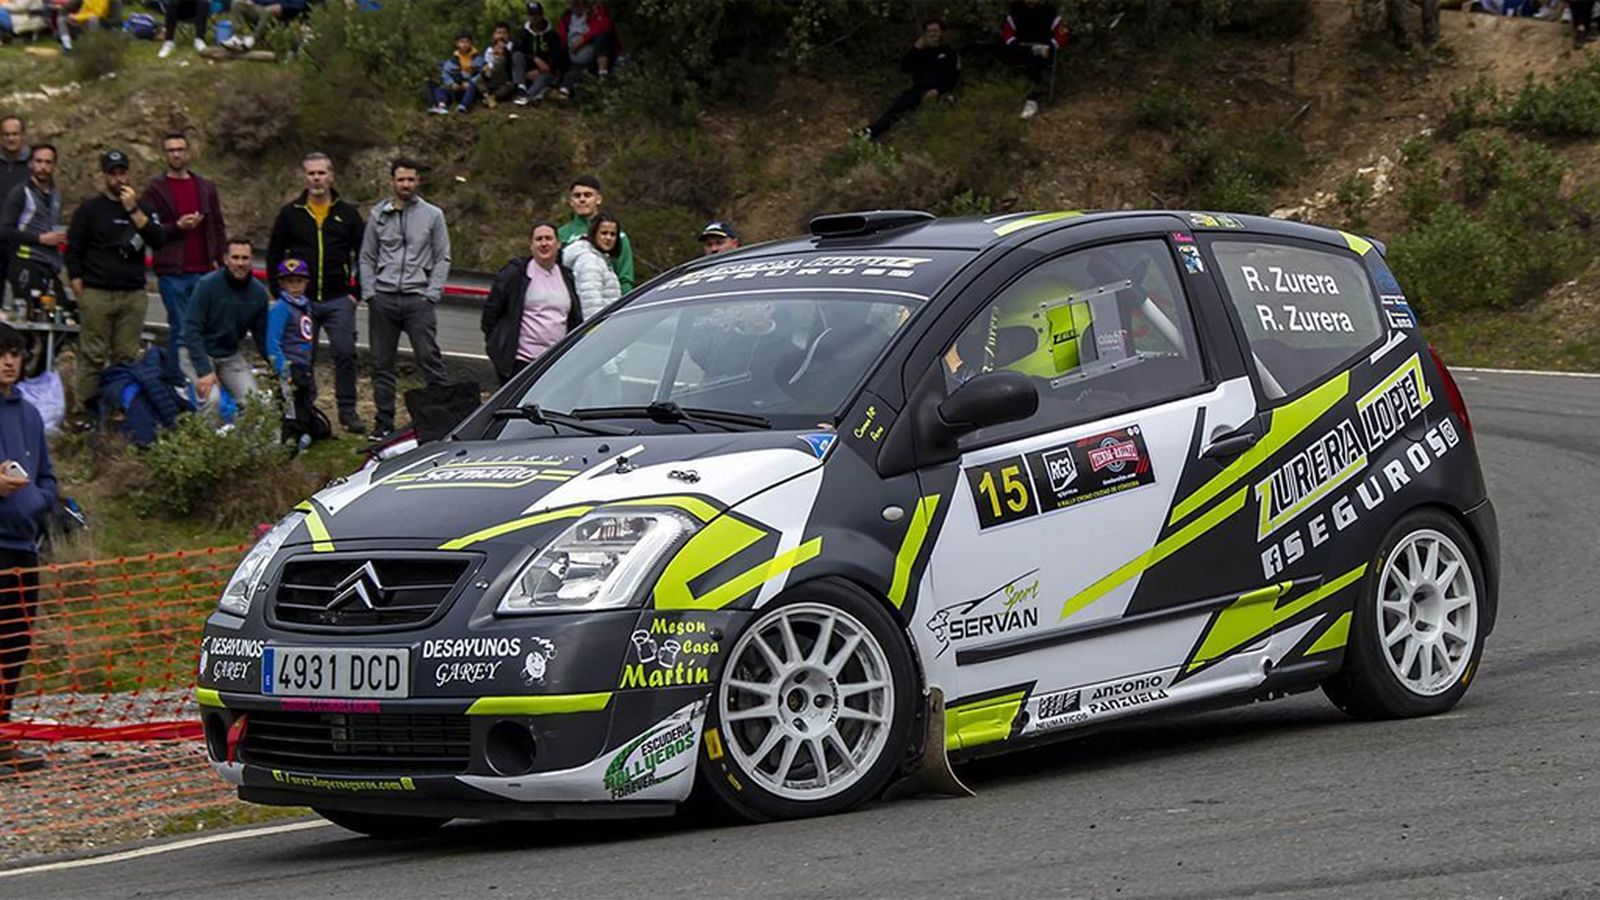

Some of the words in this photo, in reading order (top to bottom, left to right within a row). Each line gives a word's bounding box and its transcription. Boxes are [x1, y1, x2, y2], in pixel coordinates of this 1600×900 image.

[1241, 265, 1270, 292] R.
[1268, 266, 1340, 295] Zurera
[1256, 304, 1284, 331] R.
[1283, 305, 1355, 332] Zurera
[1255, 418, 1369, 543] ZURERA
[1356, 352, 1434, 453] LOPEZ
[979, 464, 1029, 518] 15
[1282, 427, 1448, 565] SEGUROS
[650, 618, 707, 636] Meson
[949, 607, 1038, 640] SERVAN
[209, 637, 265, 658] DESAYUNOS
[422, 638, 521, 659] DESAYUNOS
[682, 639, 719, 655] Casa
[213, 660, 252, 682] GAREY
[278, 653, 337, 690] 4931
[350, 654, 401, 691] DCD
[435, 660, 502, 687] GAREY
[619, 658, 709, 689] Martín
